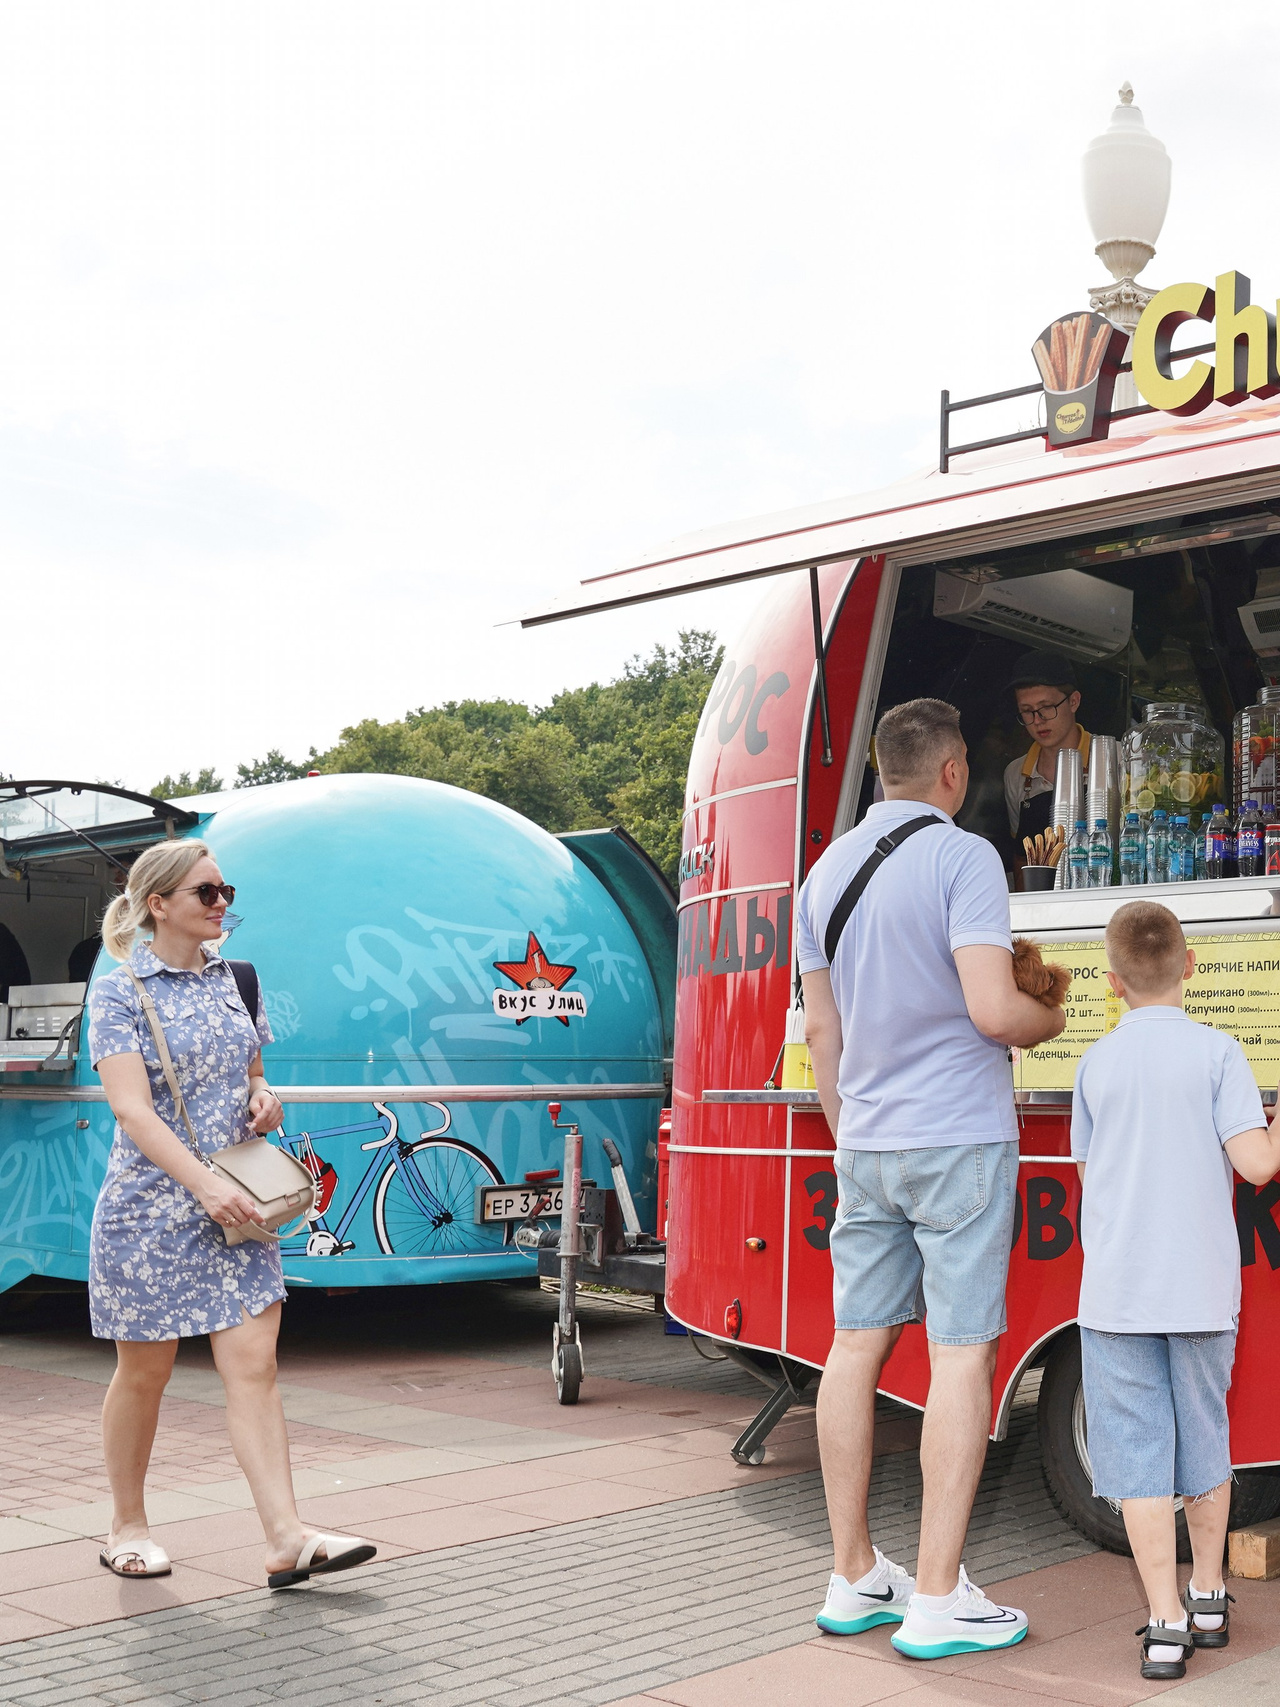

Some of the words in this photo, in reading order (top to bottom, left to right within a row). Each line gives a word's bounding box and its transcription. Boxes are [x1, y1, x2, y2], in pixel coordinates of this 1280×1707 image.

[679, 894, 791, 979] НАДЫ
[1184, 988, 1245, 1000] Американо
[1065, 1007, 1076, 1018] 12
[1184, 1004, 1235, 1016] Капучино
[1243, 1034, 1262, 1045] чай
[1027, 1049, 1071, 1061] Леденцы
